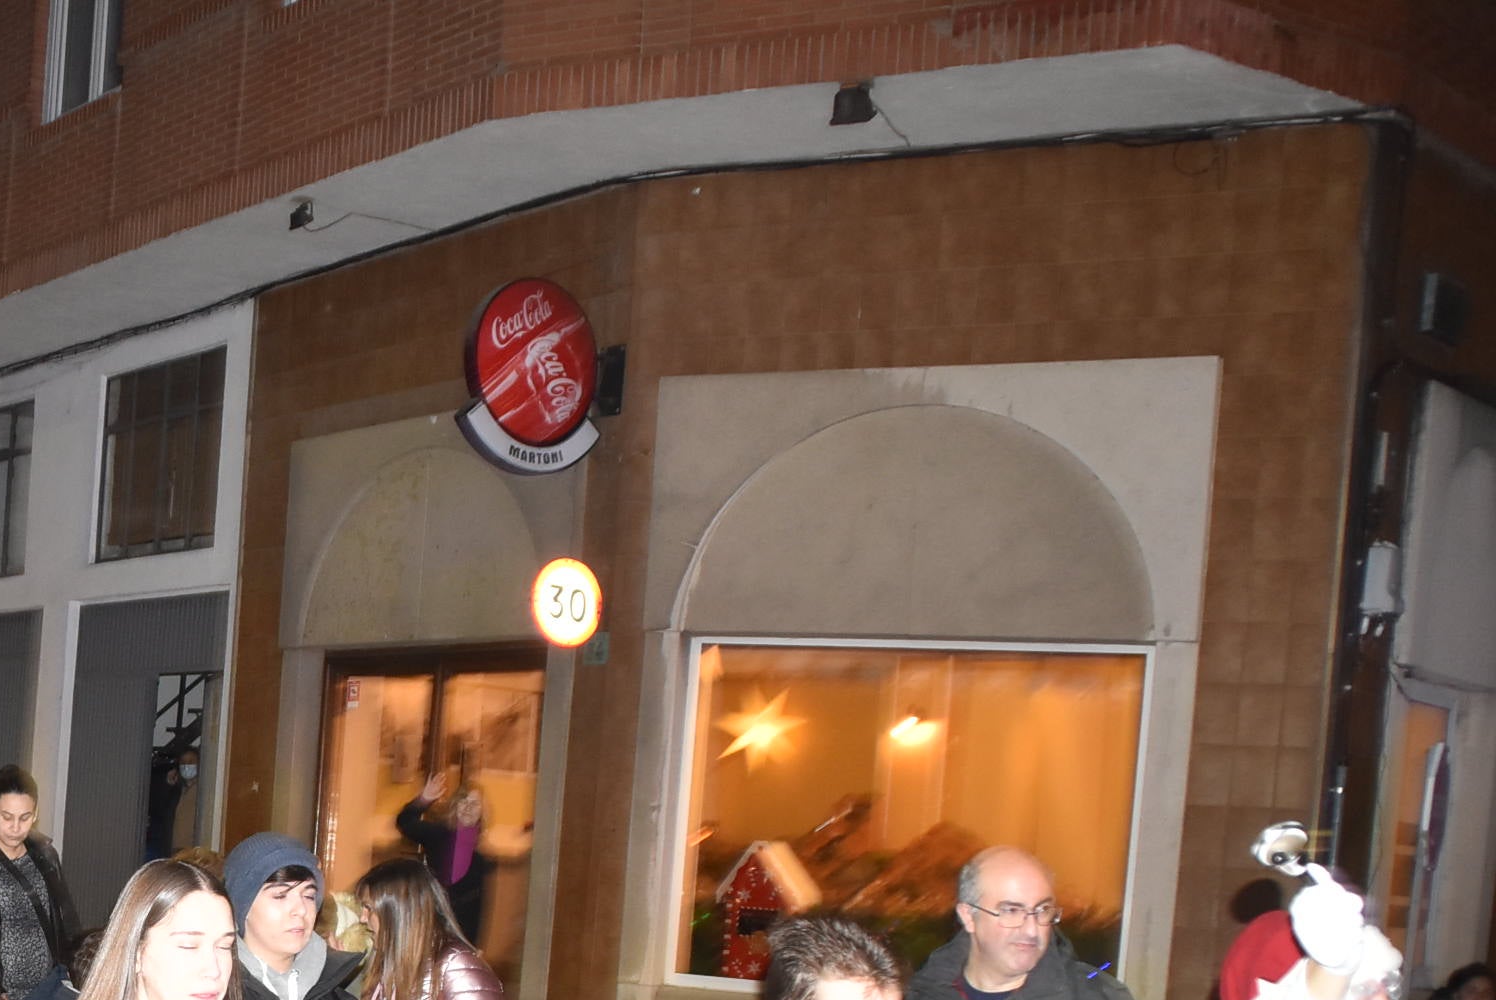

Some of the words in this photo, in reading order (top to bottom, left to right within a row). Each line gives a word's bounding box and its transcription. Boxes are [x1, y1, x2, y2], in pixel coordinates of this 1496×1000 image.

[492, 289, 553, 348] Coca-Cola
[525, 332, 583, 423] Coca-Cola
[509, 445, 564, 464] MARTONI
[549, 584, 586, 623] 30
